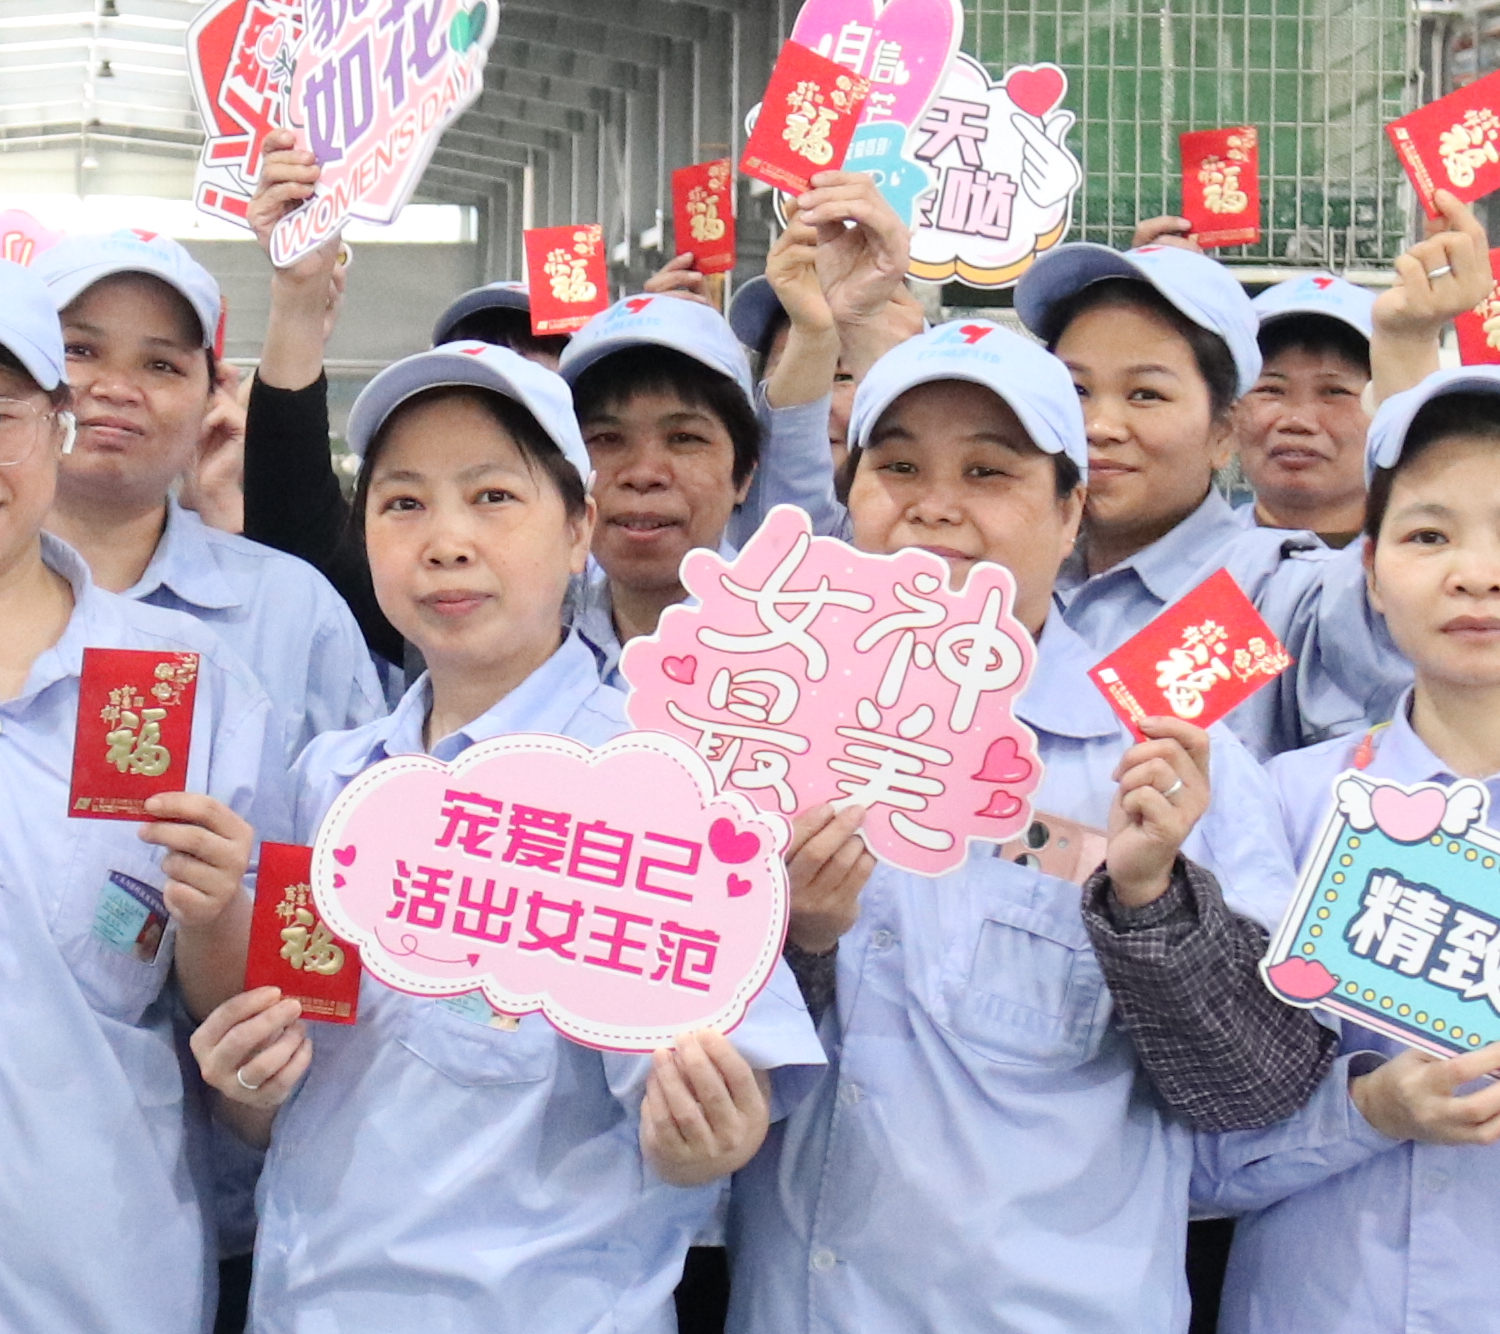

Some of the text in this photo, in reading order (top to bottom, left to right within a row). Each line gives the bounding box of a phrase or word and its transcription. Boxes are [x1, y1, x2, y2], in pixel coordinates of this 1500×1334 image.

[278, 119, 417, 257] WOMEN'S
[781, 100, 840, 165] 福
[919, 166, 1019, 242] 哒
[696, 530, 1025, 734] 女神
[105, 707, 172, 777] 福
[666, 666, 954, 852] 最美
[433, 788, 704, 905] 宠爱自己
[279, 906, 345, 976] 福
[385, 858, 721, 996] 活出女王范
